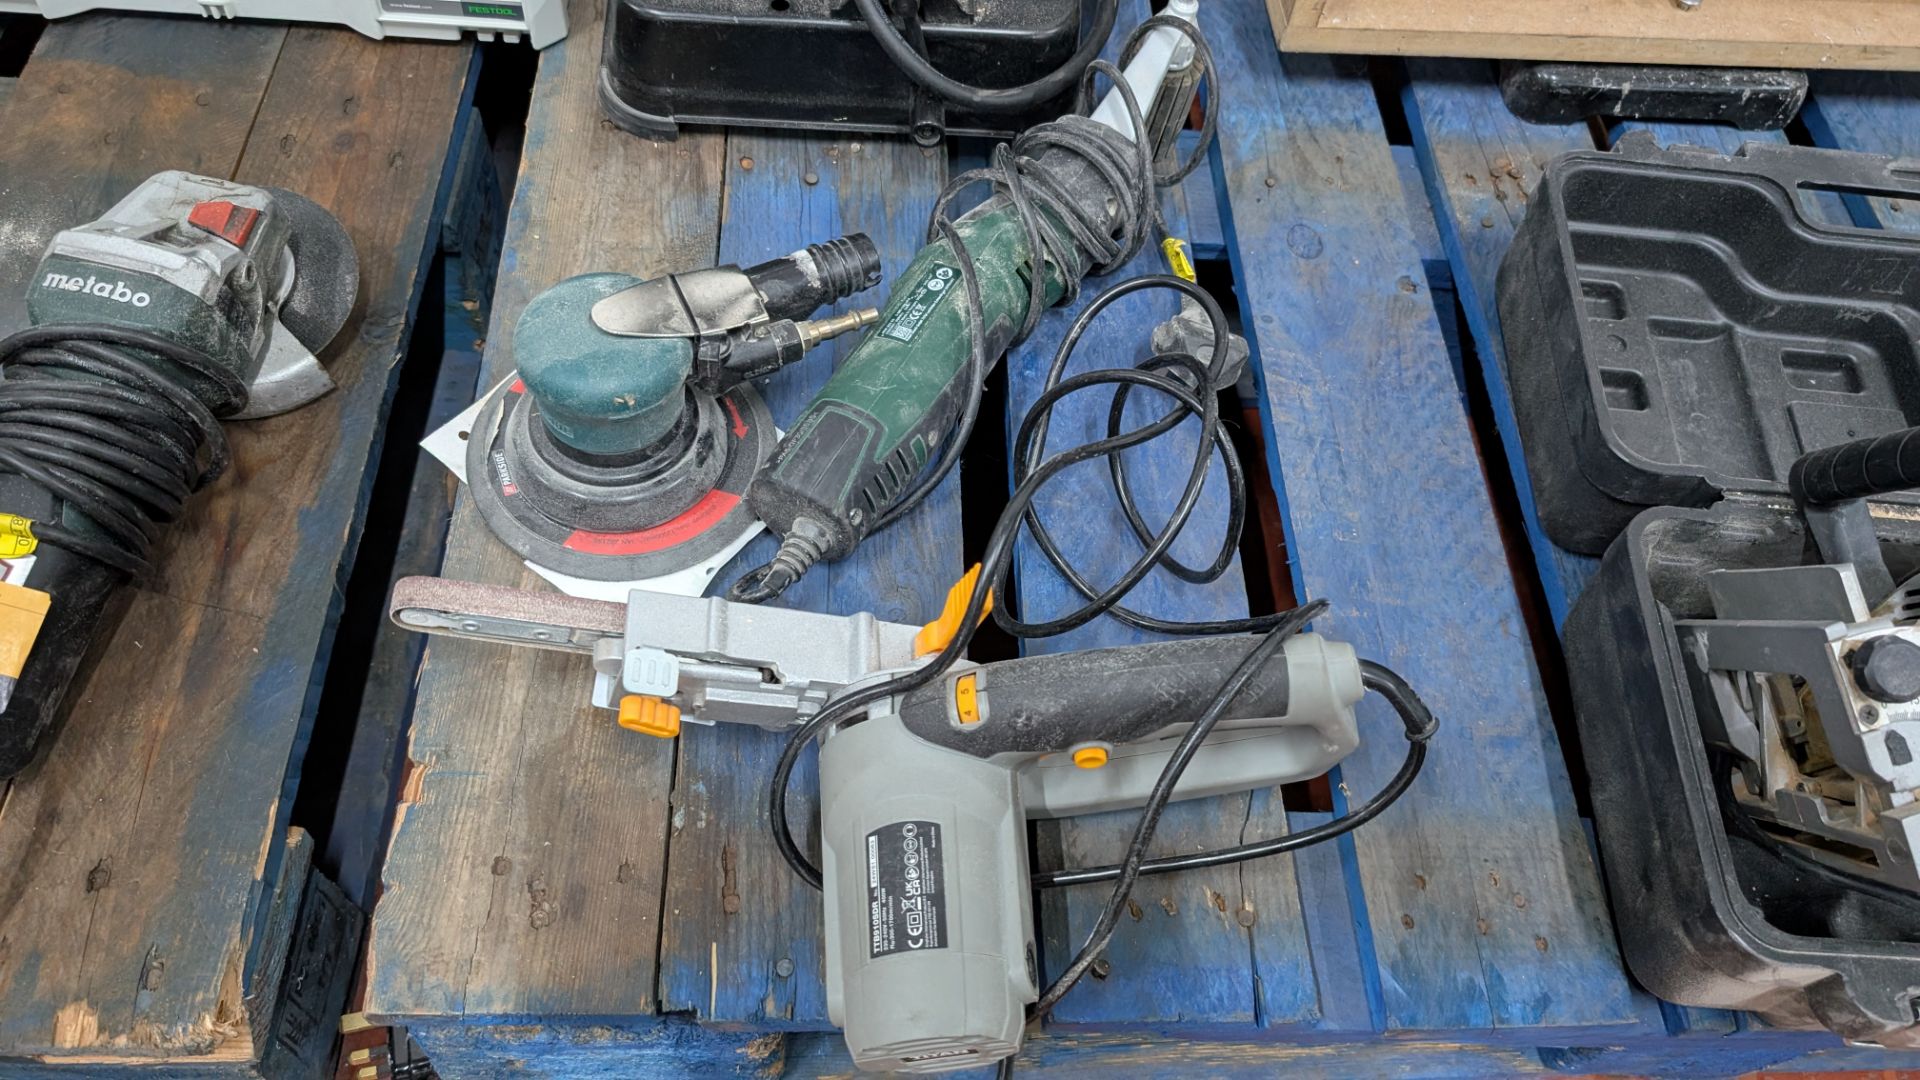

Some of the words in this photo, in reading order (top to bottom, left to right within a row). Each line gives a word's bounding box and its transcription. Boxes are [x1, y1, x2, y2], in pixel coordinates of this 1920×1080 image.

[469, 6, 517, 16] FESTOOL
[42, 273, 150, 307] metabo
[494, 451, 511, 486] PARKSIDE
